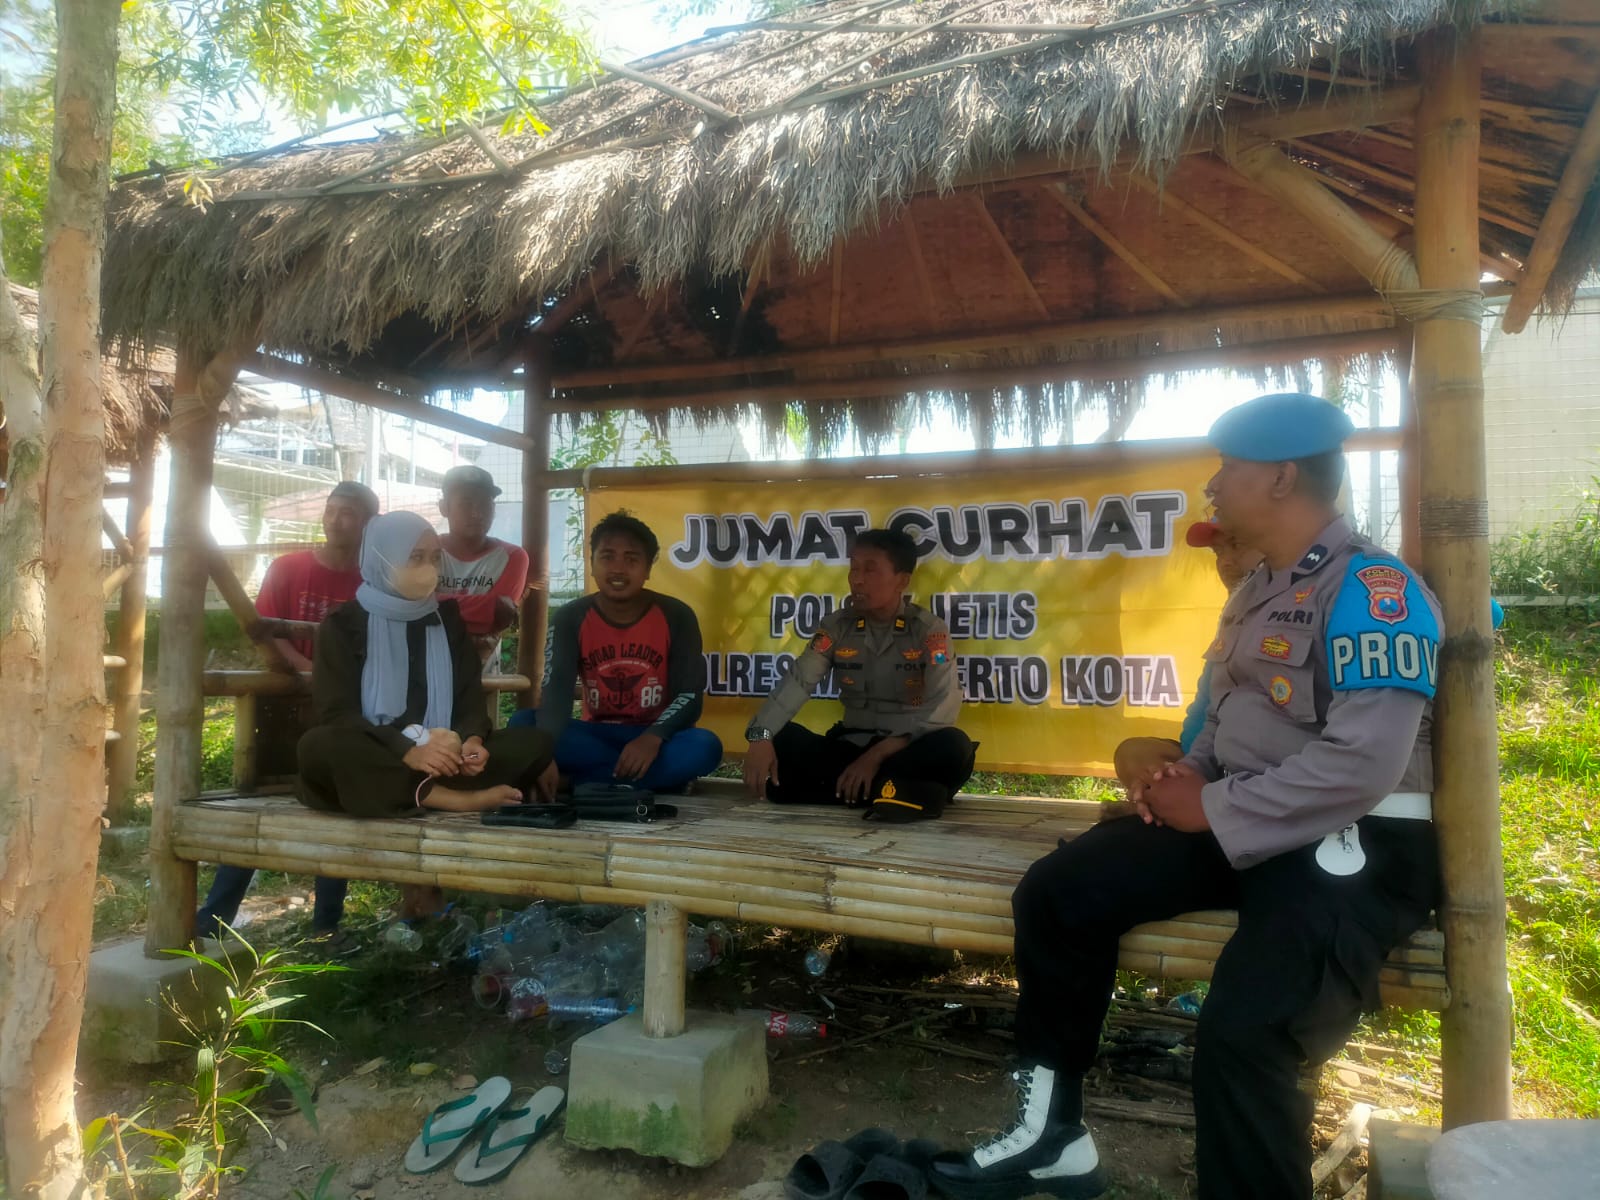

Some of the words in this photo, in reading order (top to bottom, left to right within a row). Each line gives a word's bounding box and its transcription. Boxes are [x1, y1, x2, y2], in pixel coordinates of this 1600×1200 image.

[670, 512, 868, 569] JUMAT
[887, 491, 1186, 562] CURHAT
[437, 574, 494, 589] ALIFORNIA
[1267, 609, 1314, 626] POLRI
[620, 643, 663, 670] LEADER
[1332, 631, 1438, 688] PROV
[1061, 654, 1184, 706] KOTA
[640, 684, 664, 708] 86
